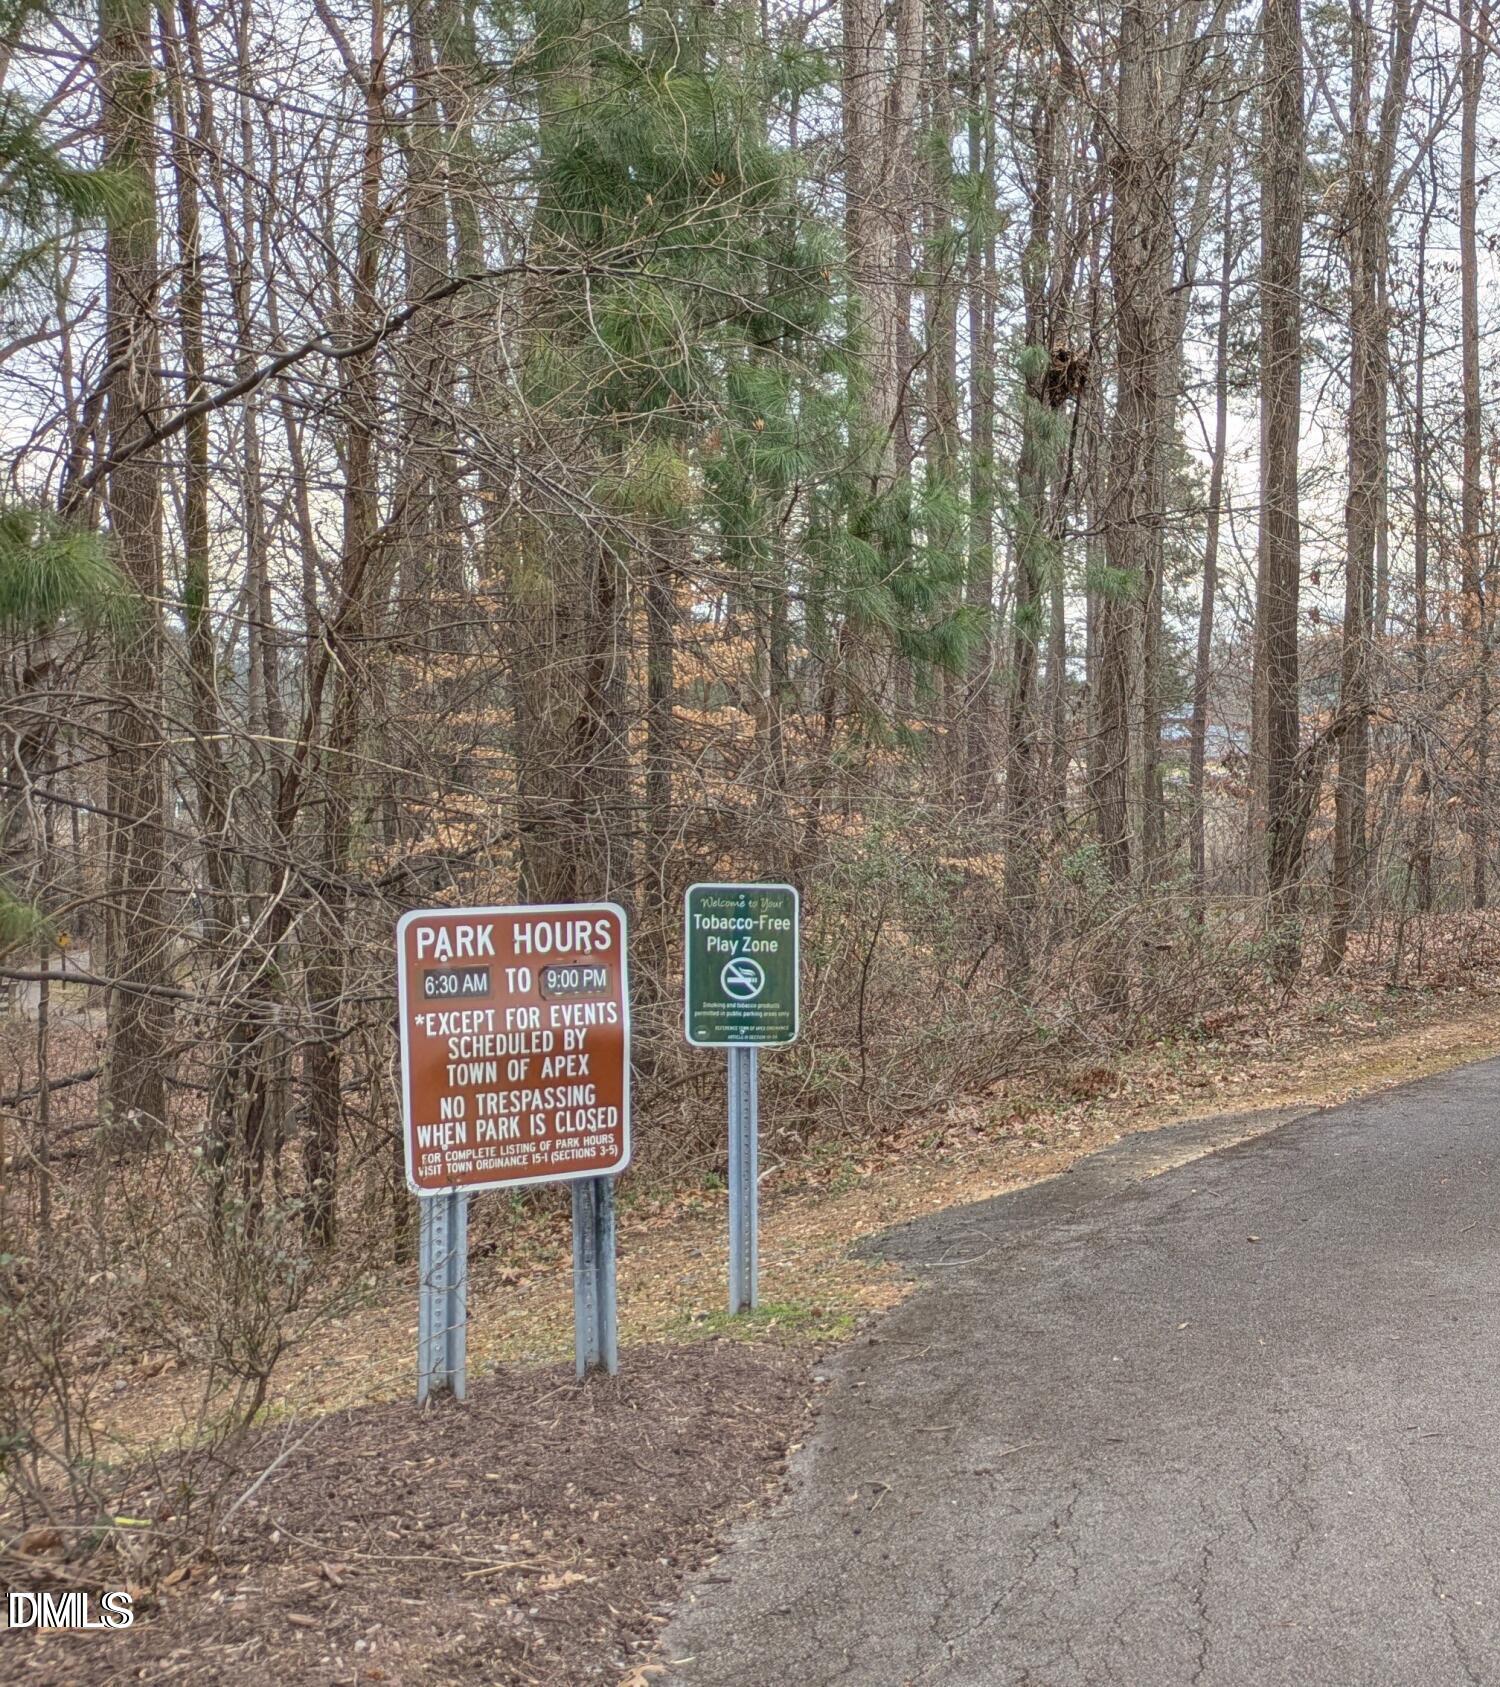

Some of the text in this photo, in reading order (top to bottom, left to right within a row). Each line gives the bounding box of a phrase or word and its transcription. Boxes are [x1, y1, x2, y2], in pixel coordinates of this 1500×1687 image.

[701, 896, 784, 913] Welcome to Your
[693, 914, 791, 930] Tobacco-Free
[417, 919, 612, 959] PARK HOURS
[707, 936, 778, 956] Play Zone
[425, 967, 607, 995] 6:30 AM TO 9:00 PM
[506, 1007, 540, 1030] FOR
[551, 1002, 618, 1027] EVENTS
[448, 1028, 588, 1059] SCHEDULED BY
[446, 1054, 589, 1087] TOWN OF APEX
[440, 1084, 596, 1120] NO TRESPASSING
[417, 1107, 618, 1148] WHEN PARK IS CLOSED
[418, 1145, 618, 1177] VISIT TOWN ORDINANCE 15-1 (SECTIONS 3-5)
[422, 1133, 615, 1165] FOR COMPLETE LISTING OF PARK HOURS
